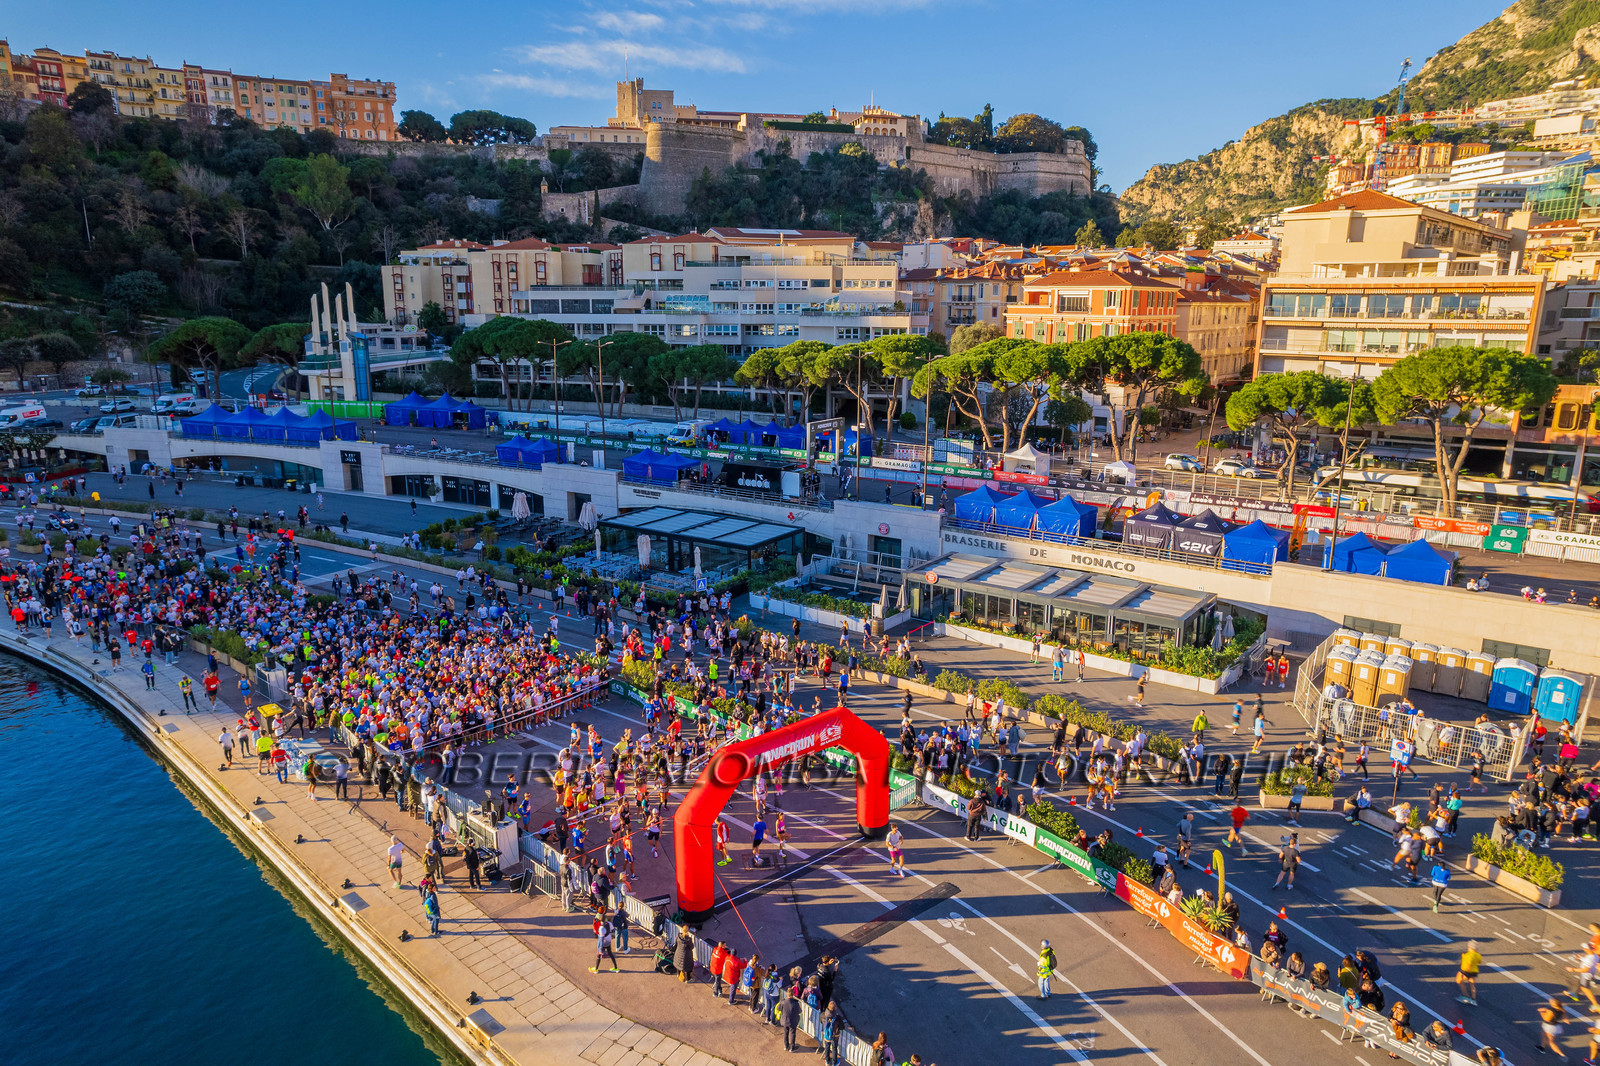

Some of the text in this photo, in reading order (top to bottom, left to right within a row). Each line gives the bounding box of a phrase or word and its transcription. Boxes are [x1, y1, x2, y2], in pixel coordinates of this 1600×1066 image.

[884, 461, 918, 470] GRAMAGLIA
[738, 471, 771, 489] diadora
[944, 533, 1136, 573] BRASSERIE DE MONACO
[1180, 541, 1214, 555] 42K
[951, 799, 1028, 838] GRAGLIA
[1037, 834, 1092, 872] MONACORUN
[1124, 880, 1154, 902] Carrefour
[1131, 893, 1152, 910] market
[1182, 920, 1214, 947] Carrefour
[1188, 936, 1213, 954] market
[1262, 971, 1341, 1012] RUNNING
